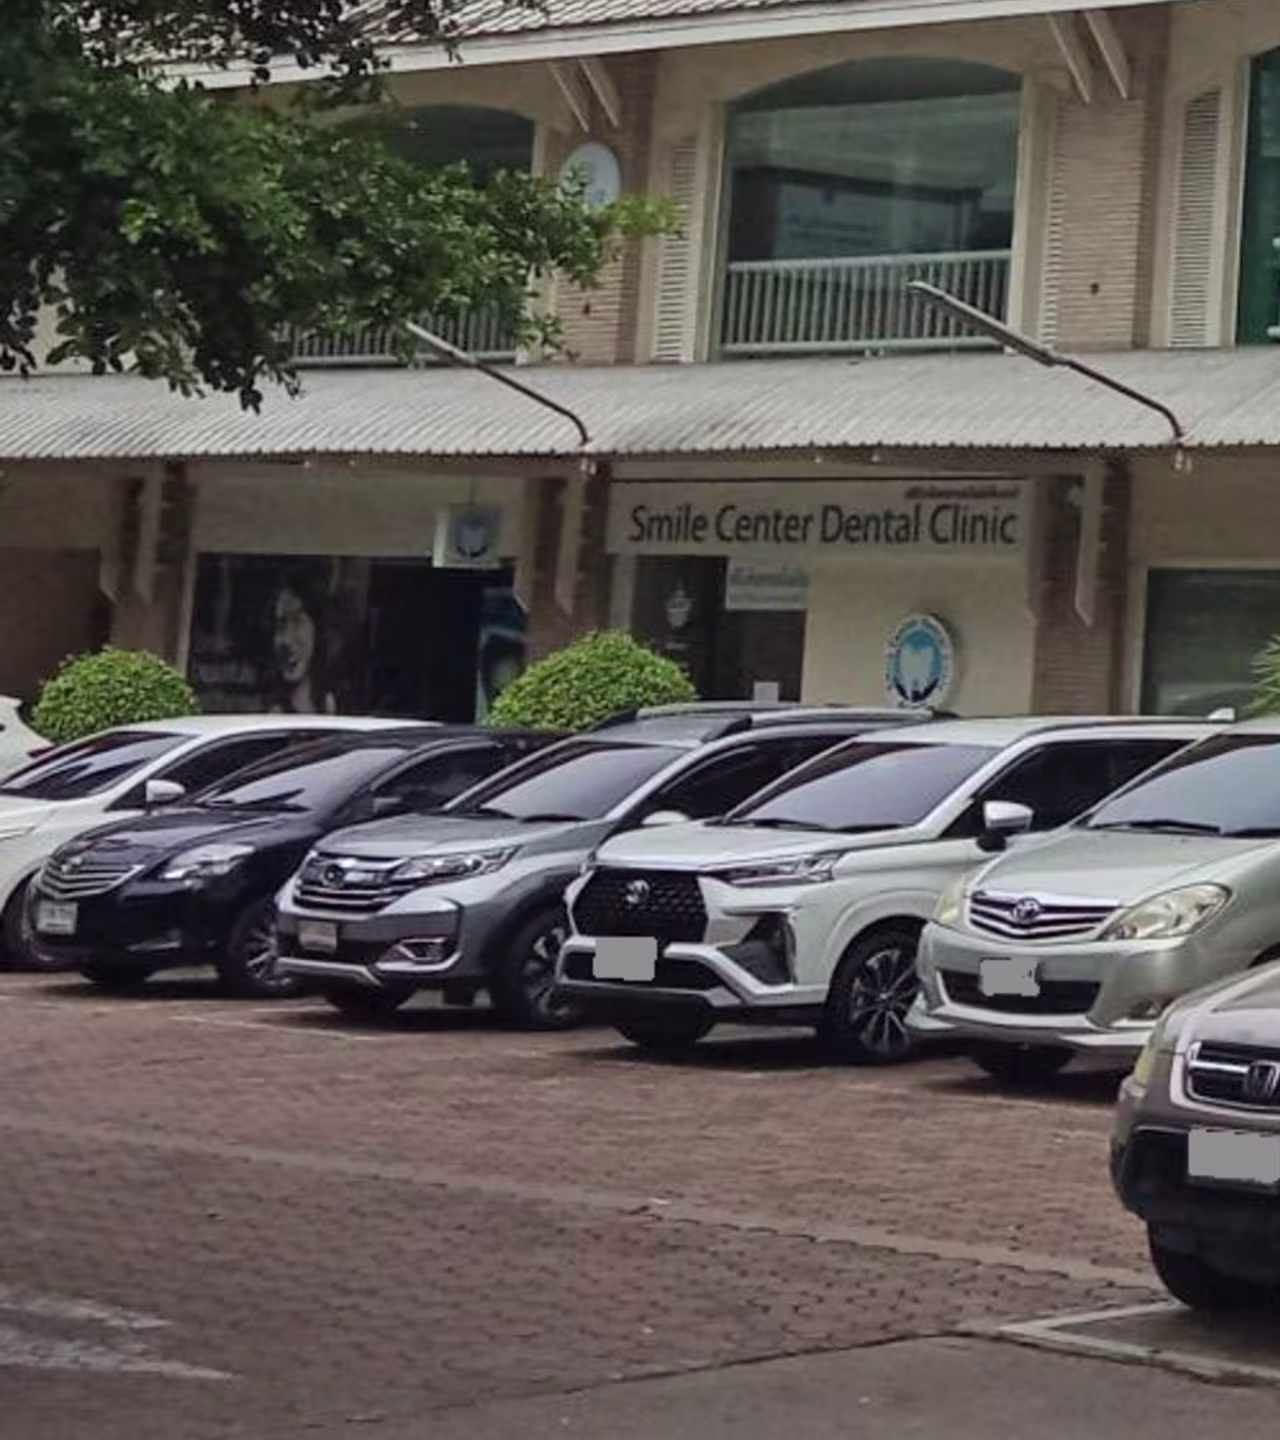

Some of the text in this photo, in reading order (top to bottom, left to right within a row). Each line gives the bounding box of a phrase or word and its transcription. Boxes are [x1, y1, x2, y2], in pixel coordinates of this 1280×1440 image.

[628, 502, 1018, 545] Smile Center Dental Clinic
